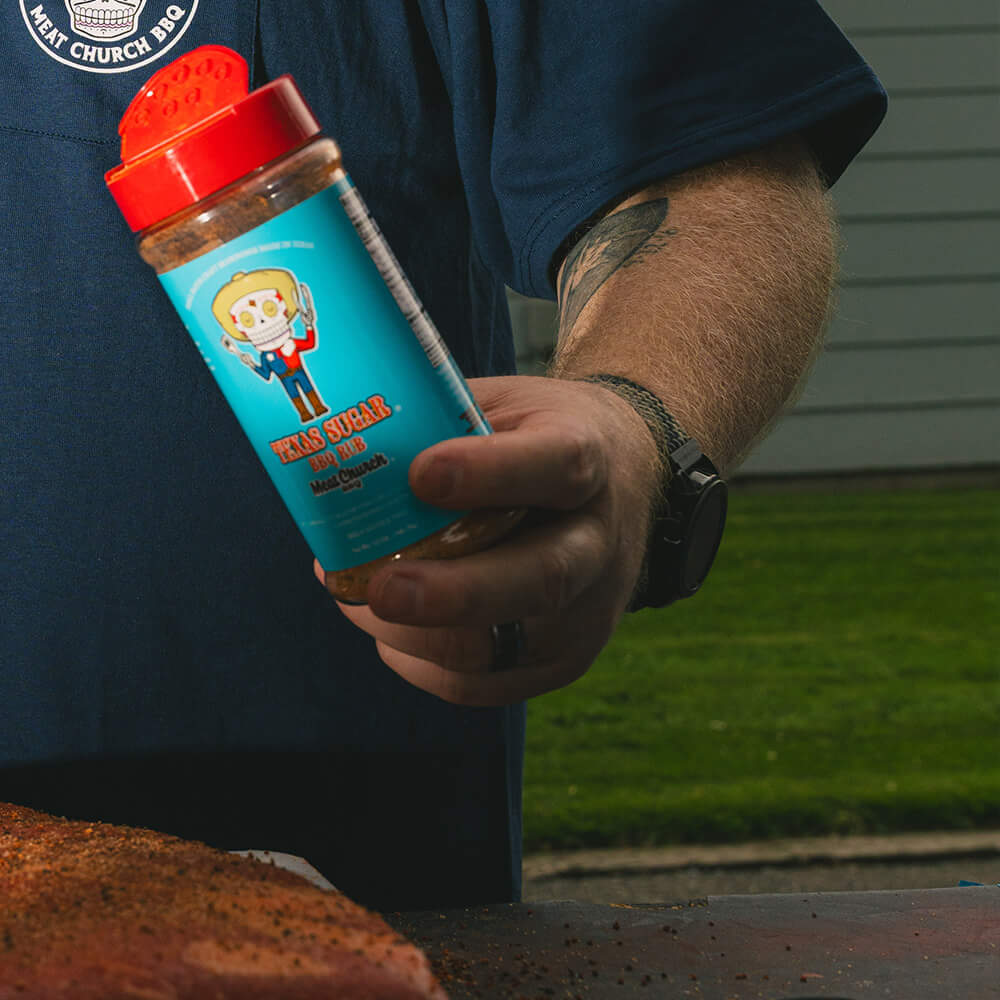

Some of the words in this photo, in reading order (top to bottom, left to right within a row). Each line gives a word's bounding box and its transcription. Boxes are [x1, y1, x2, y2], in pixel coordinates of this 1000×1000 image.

[30, 4, 69, 49] MEAT
[70, 36, 153, 64] CHURCH
[150, 5, 186, 44] BBQ
[269, 426, 327, 464] TEXAS
[322, 394, 392, 444] SUGAR
[308, 450, 339, 473] BBQ
[335, 436, 368, 461] RUB
[309, 473, 340, 496] Meat
[338, 452, 390, 484] Church
